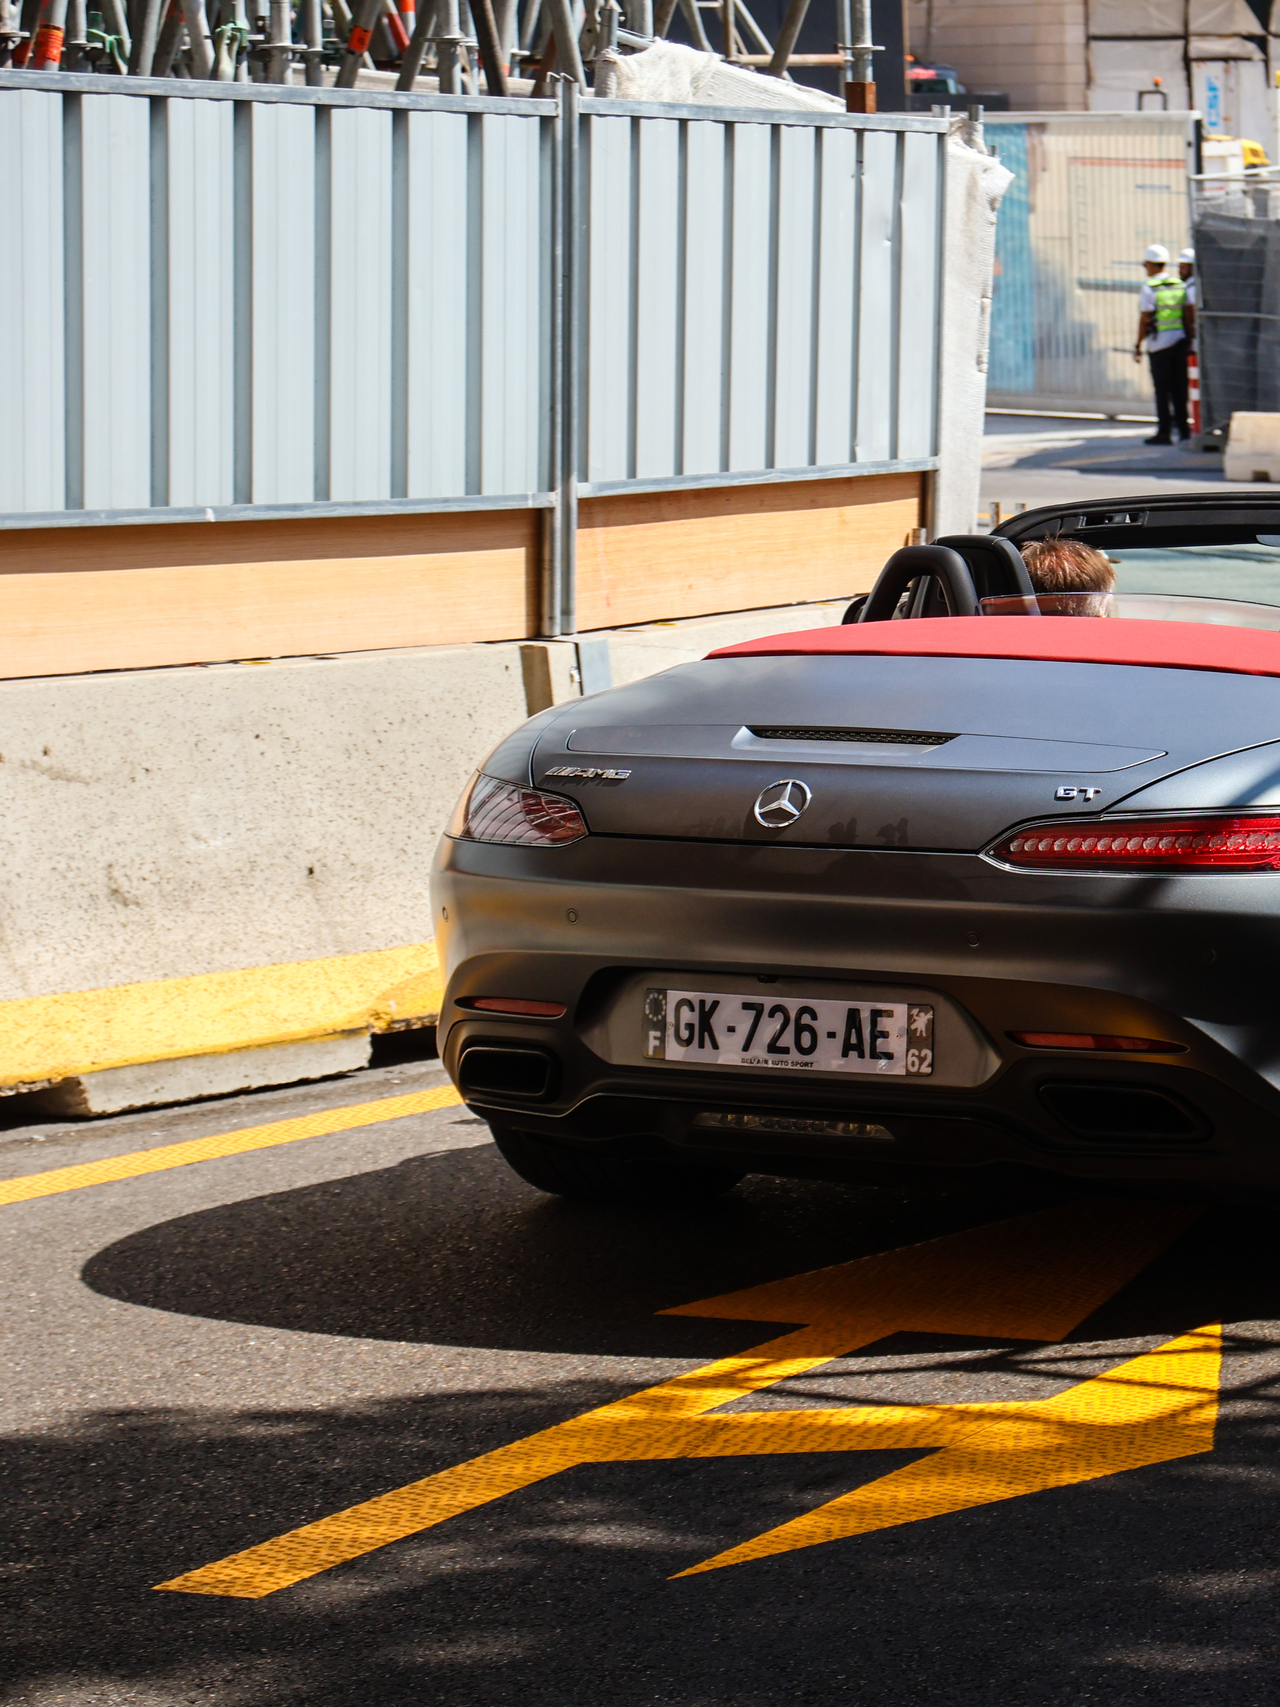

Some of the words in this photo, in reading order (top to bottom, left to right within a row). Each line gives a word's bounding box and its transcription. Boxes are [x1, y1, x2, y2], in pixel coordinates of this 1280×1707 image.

[564, 766, 632, 779] AMG
[1056, 786, 1102, 800] GT
[673, 997, 895, 1061] GK-726-AE
[647, 1030, 661, 1056] F
[790, 1060, 814, 1068] SPORT
[907, 1048, 932, 1074] 62
